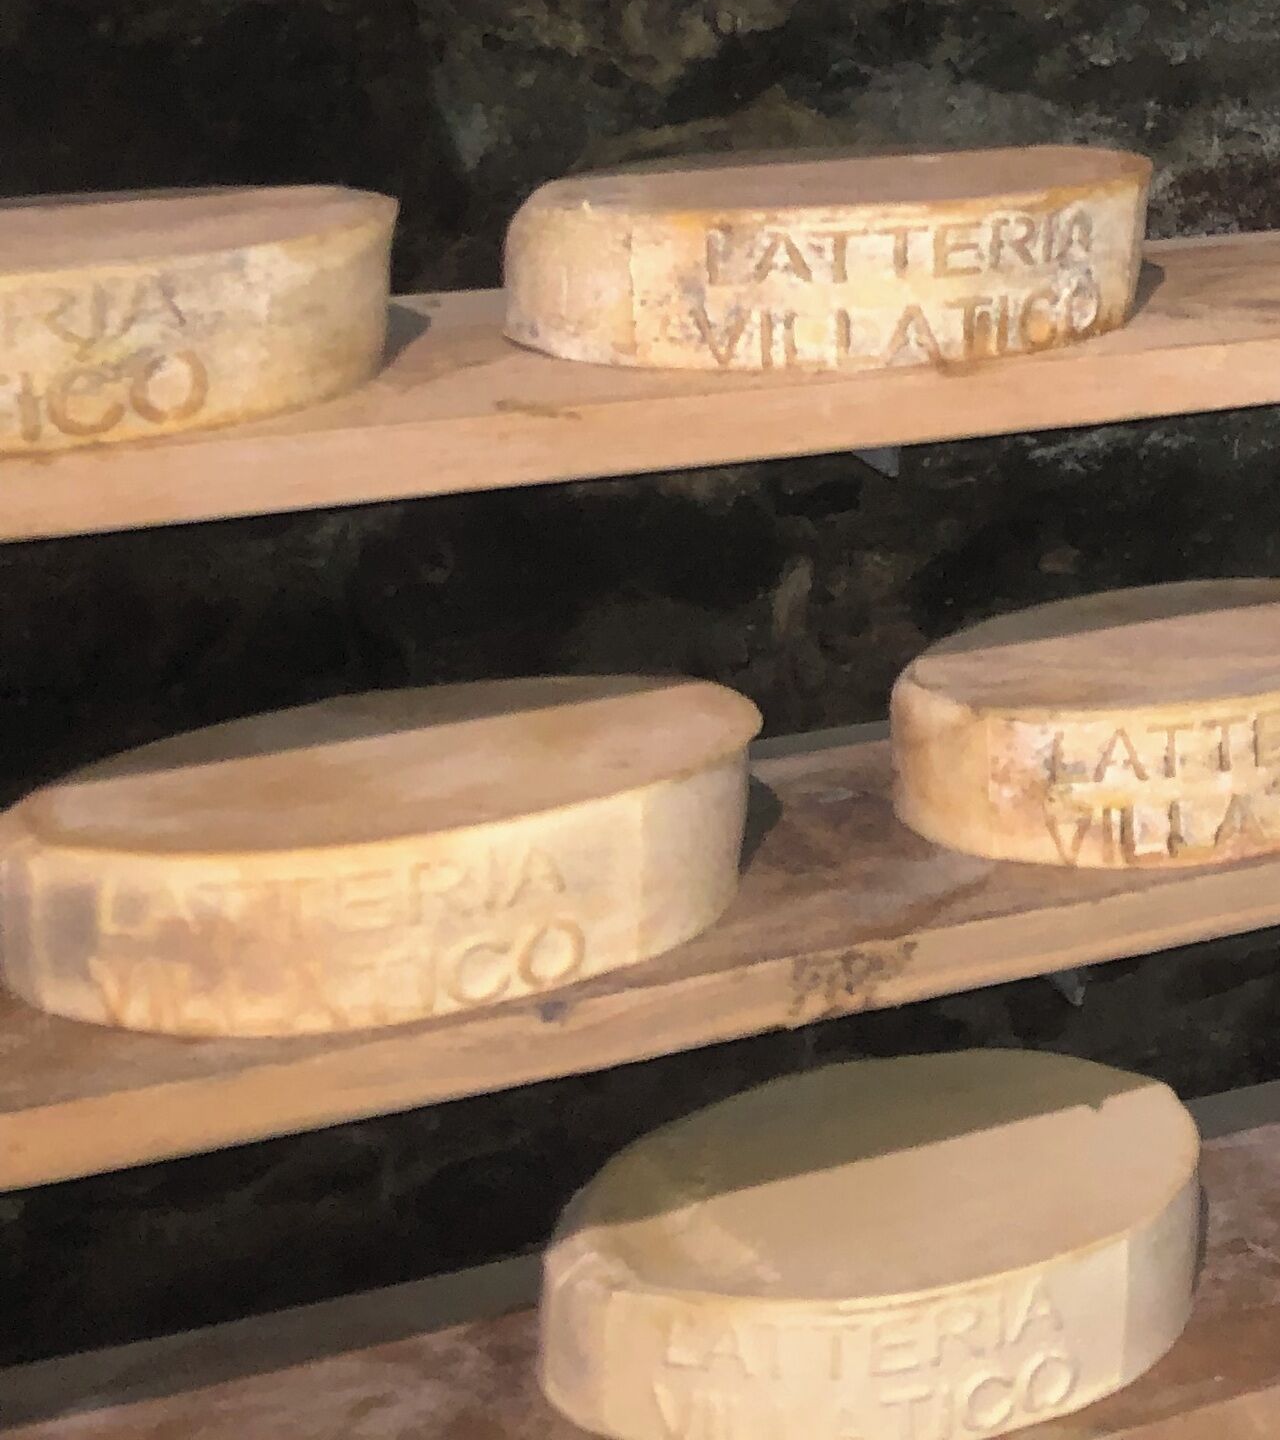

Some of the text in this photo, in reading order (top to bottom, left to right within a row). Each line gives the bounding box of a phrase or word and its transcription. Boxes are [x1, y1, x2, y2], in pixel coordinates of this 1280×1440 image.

[702, 205, 1094, 286] LATTERIA
[696, 268, 1100, 371] VILLATICO
[664, 1275, 1064, 1382] LATTERIA
